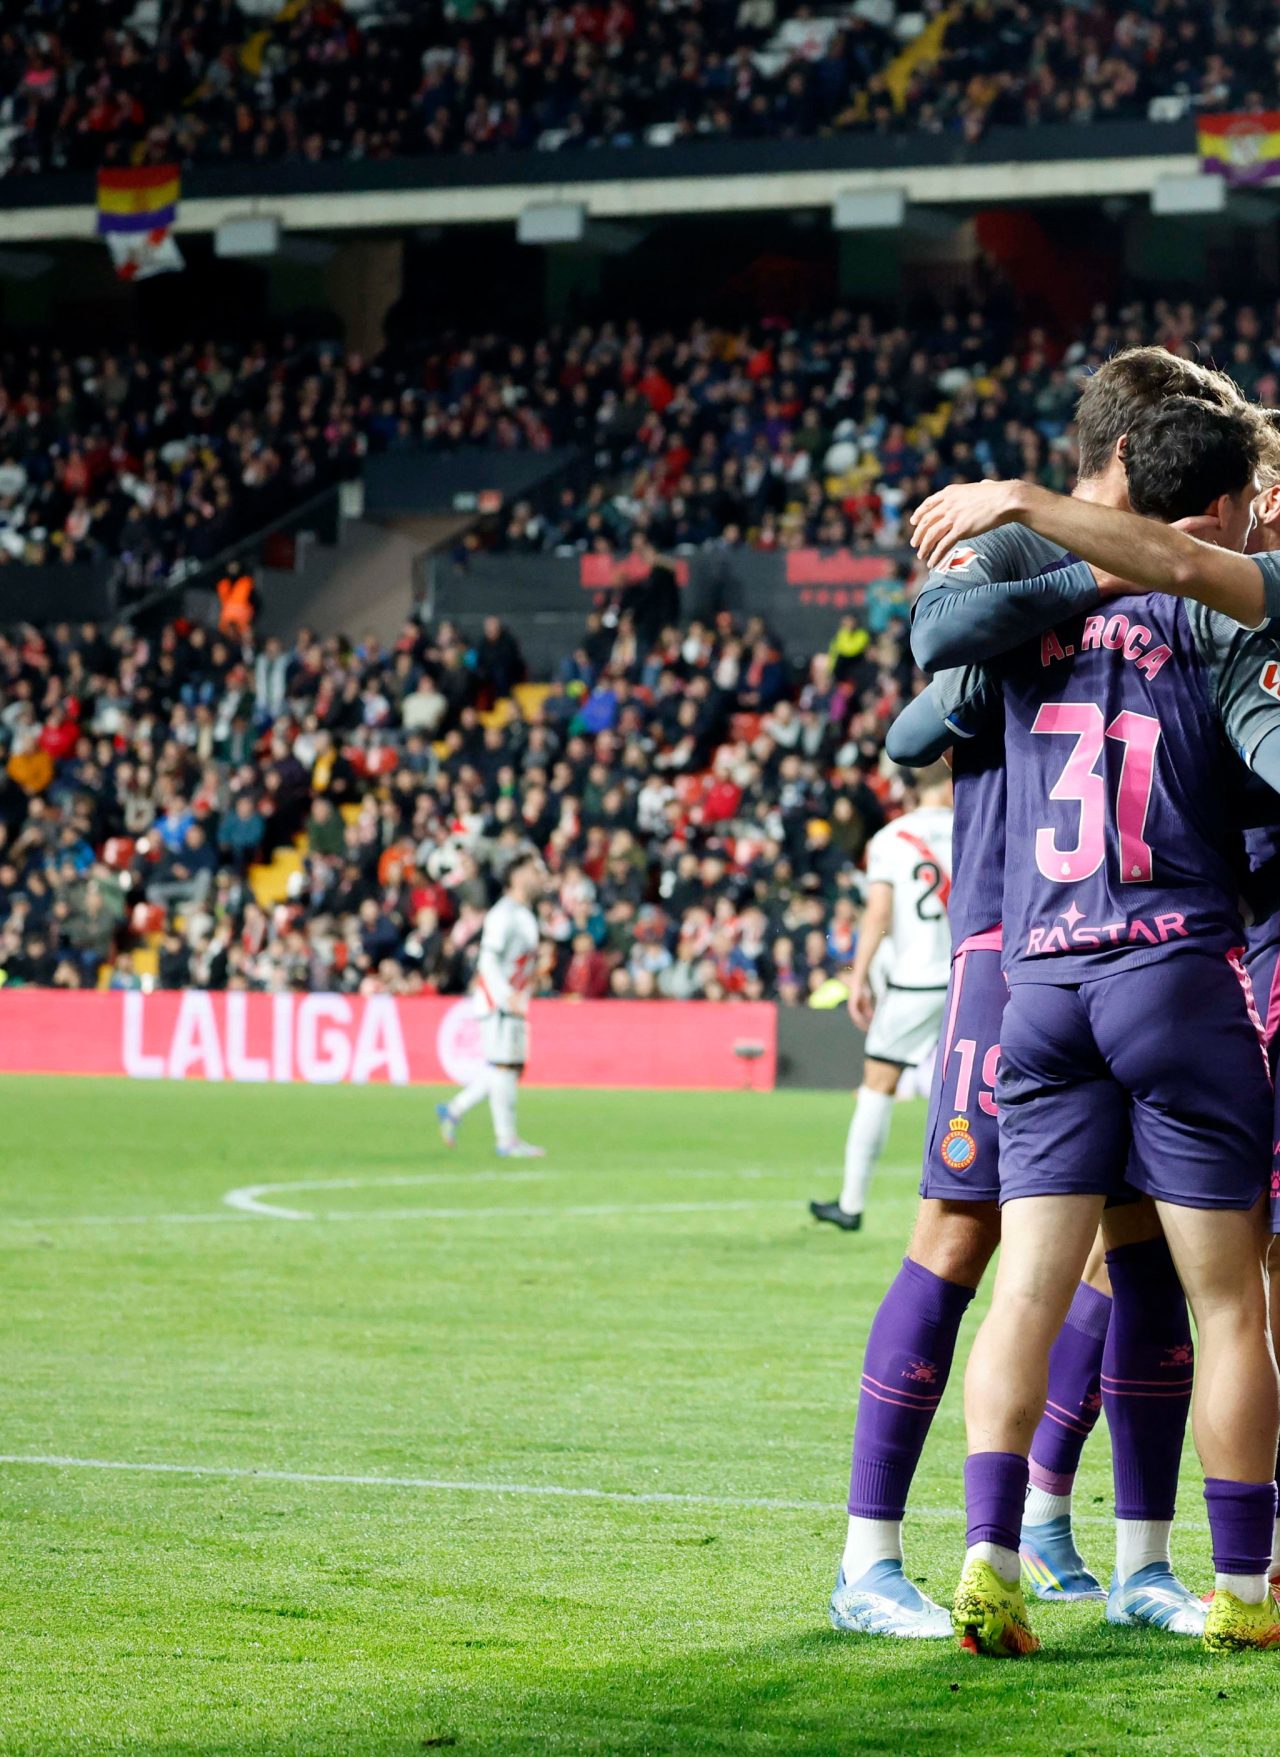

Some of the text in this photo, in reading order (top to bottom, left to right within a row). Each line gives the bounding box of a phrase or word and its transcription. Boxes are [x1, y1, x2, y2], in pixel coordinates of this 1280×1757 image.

[1041, 614, 1173, 682] A. ROCA
[1030, 702, 1162, 884] 31
[1026, 911, 1190, 955] RASTAR
[122, 989, 410, 1085] LALIGA
